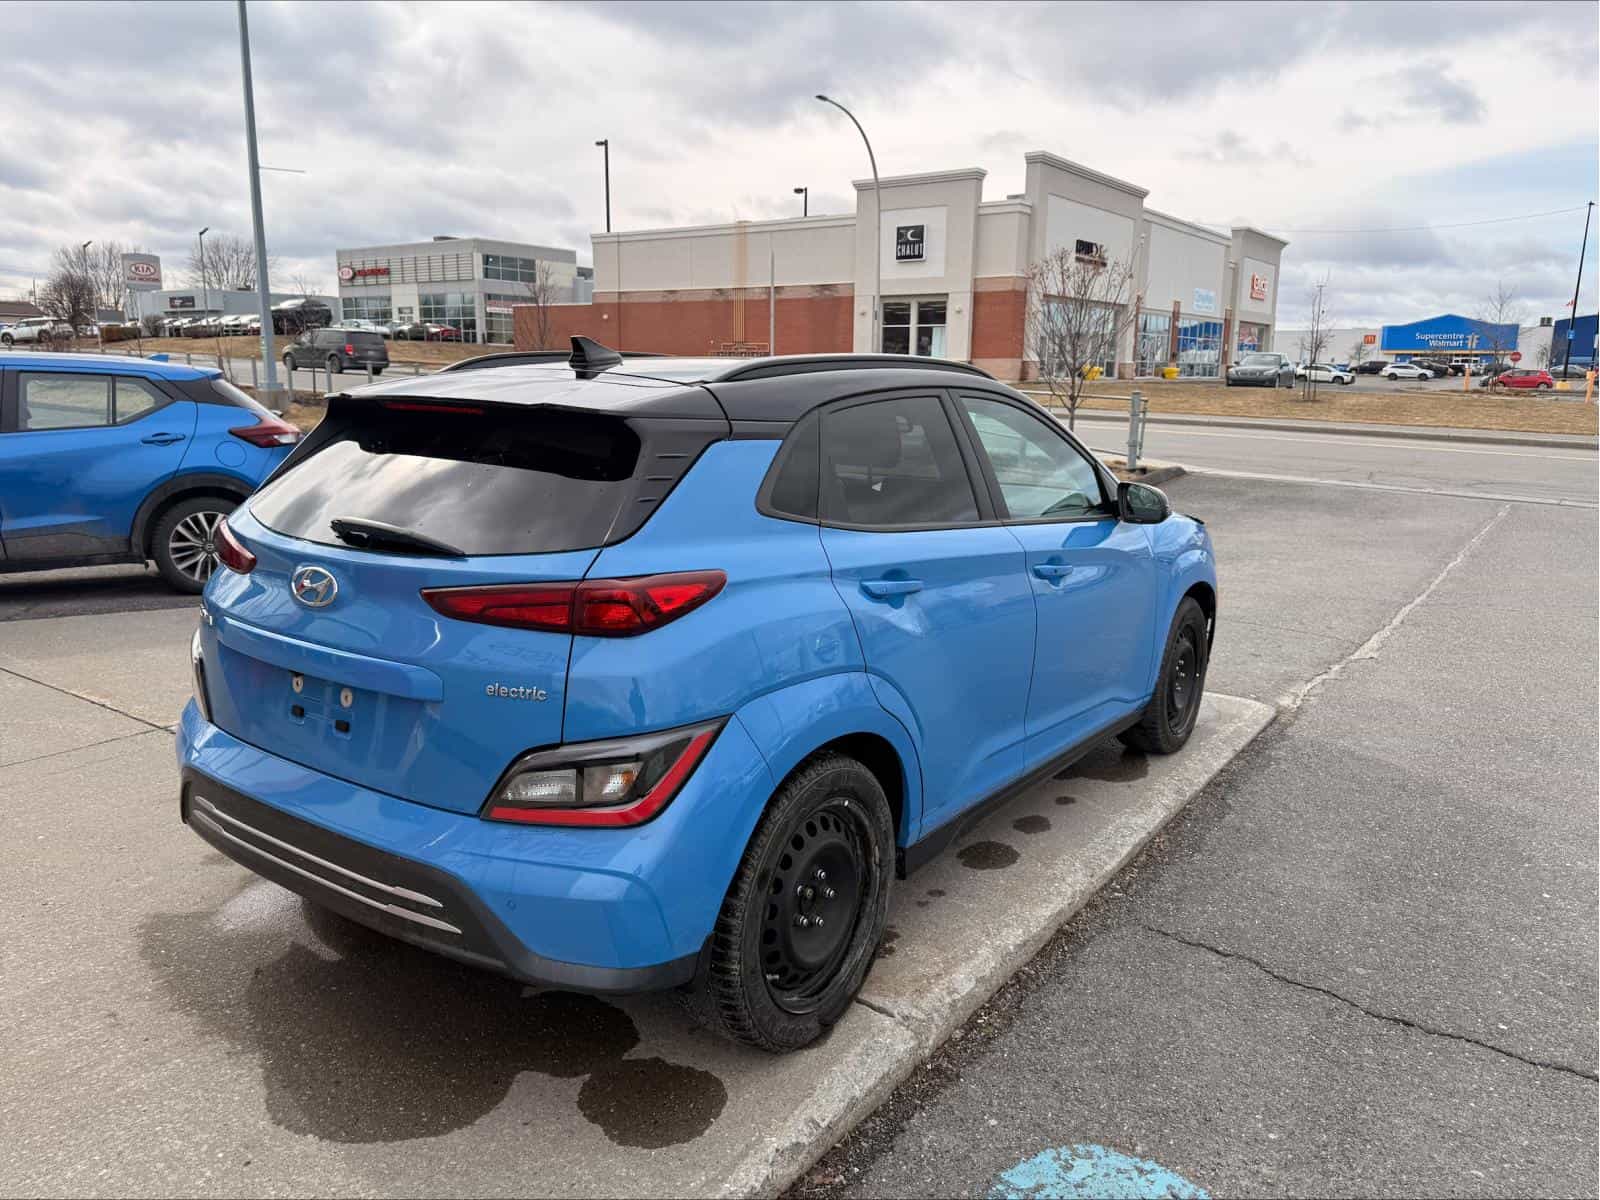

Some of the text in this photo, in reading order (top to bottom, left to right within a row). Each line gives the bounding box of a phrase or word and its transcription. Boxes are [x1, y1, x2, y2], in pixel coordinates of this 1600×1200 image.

[132, 263, 155, 275] KIA
[1416, 333, 1464, 342] Supercentre
[1429, 340, 1463, 348] Walmart
[487, 682, 547, 701] electric
